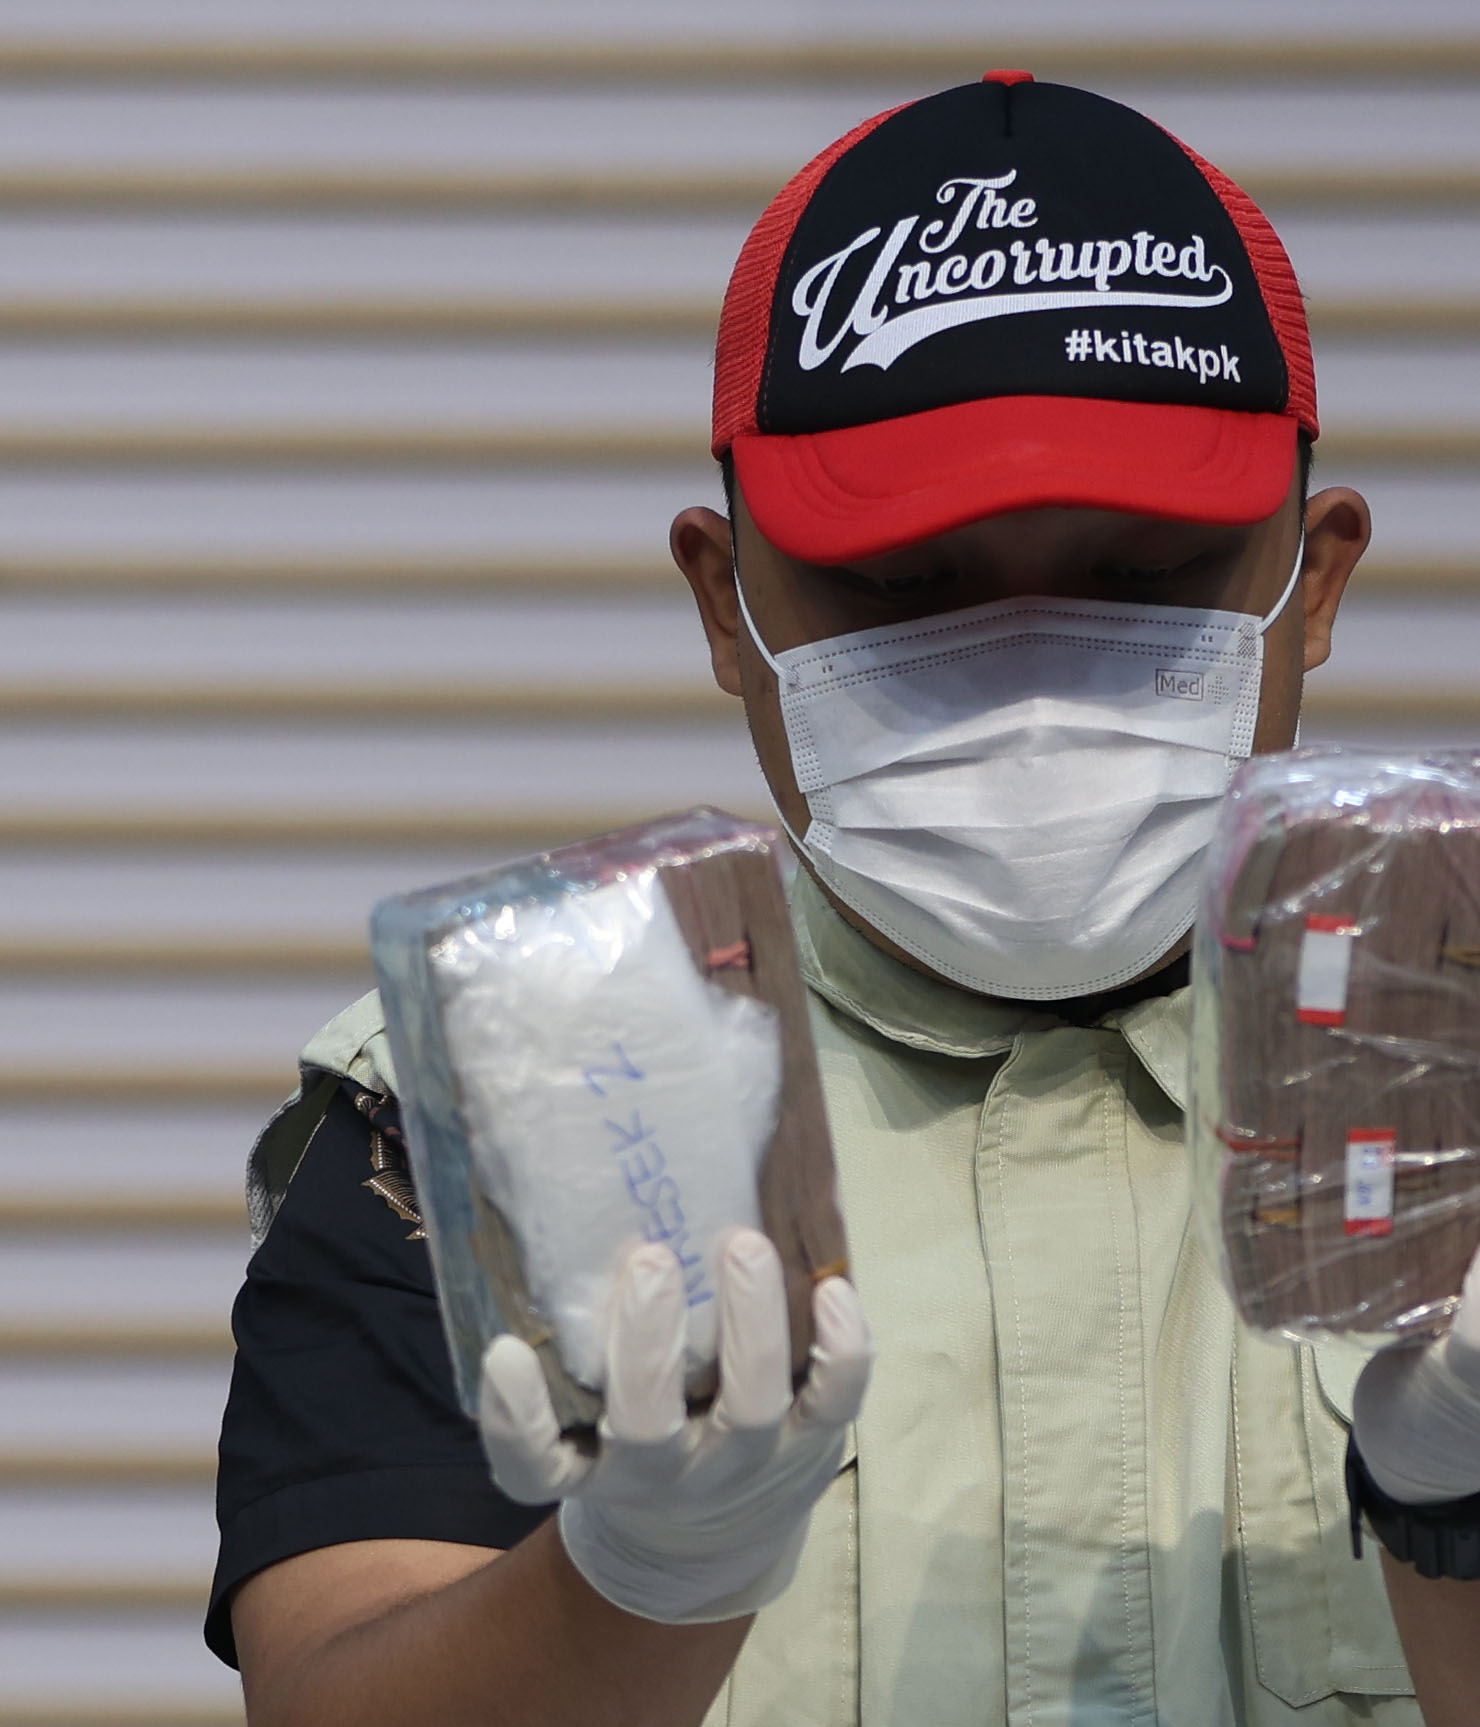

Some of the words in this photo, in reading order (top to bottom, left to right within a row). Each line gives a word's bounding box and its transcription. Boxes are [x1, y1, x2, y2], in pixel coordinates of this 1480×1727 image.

[919, 169, 1038, 253] The
[792, 215, 1233, 371] Uncorrupted
[1065, 328, 1241, 383] #kitakpk
[1160, 674, 1200, 696] Med
